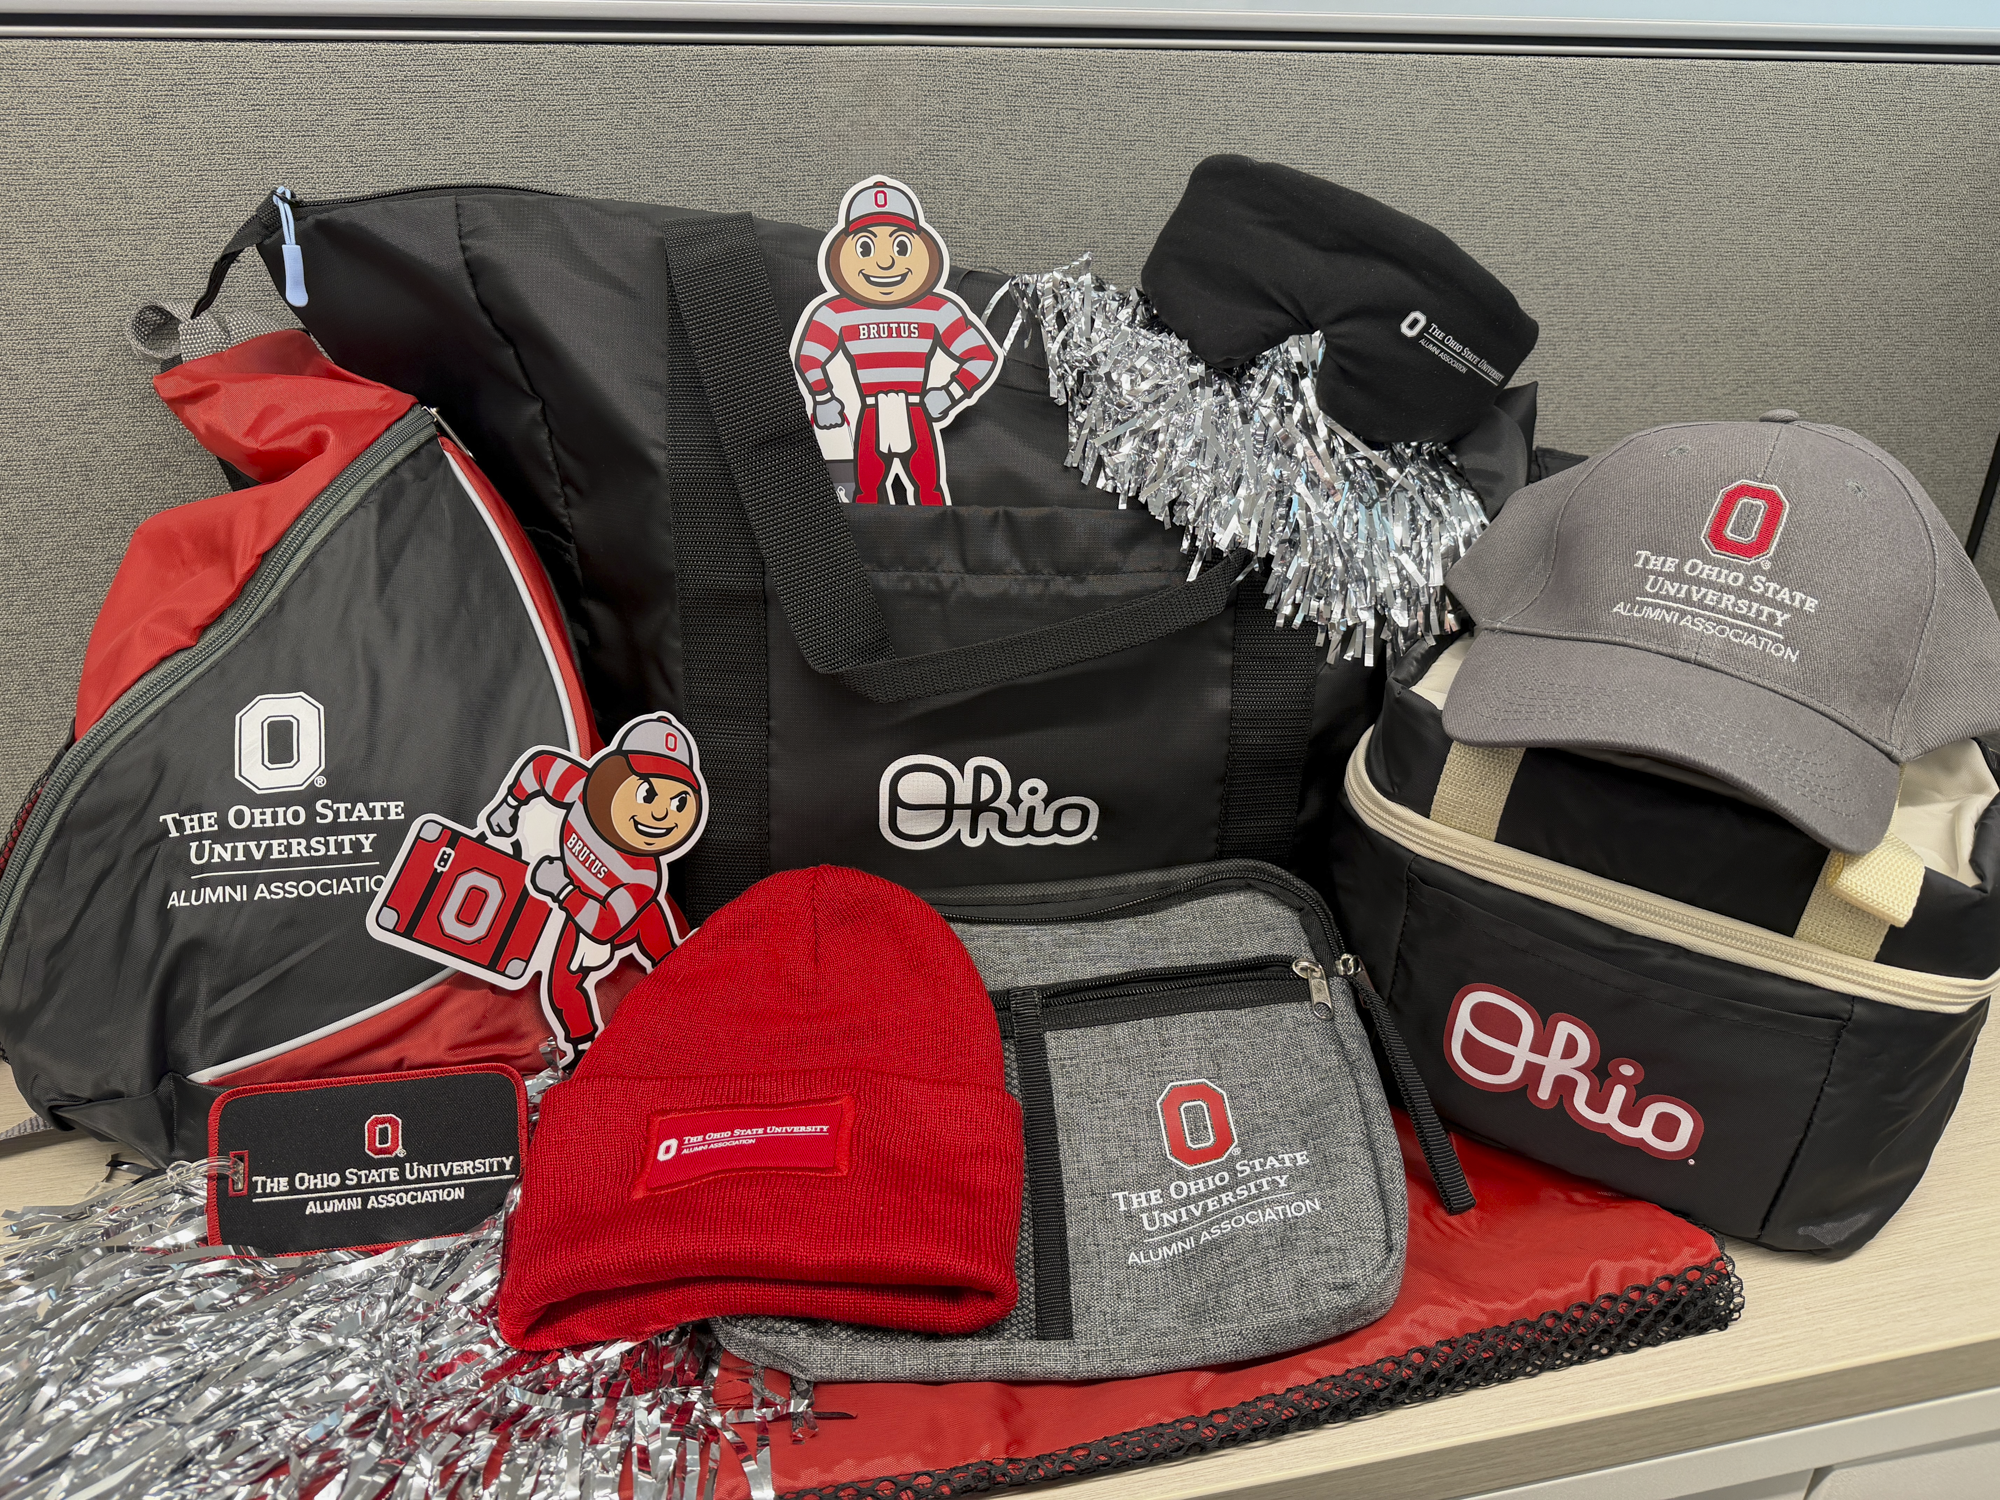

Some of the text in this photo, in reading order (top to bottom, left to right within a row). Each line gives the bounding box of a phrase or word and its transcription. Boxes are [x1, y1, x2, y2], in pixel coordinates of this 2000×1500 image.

[874, 189, 888, 209] O
[858, 322, 920, 340] BRUTUS
[1400, 310, 1427, 338] O
[1418, 338, 1468, 374] ALUMNI ASSOCIATION
[1428, 323, 1505, 382] THE OHIO STATE UNIVERSITY
[1701, 479, 1789, 565] O
[1633, 550, 1819, 613] THE OHIO STATE
[1645, 575, 1791, 627] UNIVERSITY
[1612, 601, 1800, 662] ALUMNI ASSOCIATION
[235, 691, 325, 794] O
[665, 732, 678, 752] O
[159, 799, 405, 838] THE OHIO STATE
[879, 754, 1099, 850] Ohio
[189, 833, 377, 865] UNIVERSITY
[567, 833, 608, 879] BRUTUS
[166, 874, 386, 909] ALUMNI ASSOCIATIO
[437, 867, 506, 945] O
[1444, 984, 1703, 1159] Ohio
[364, 1113, 402, 1158] O
[681, 1138, 756, 1155] ALUMNI ASSOCIATION
[683, 1125, 829, 1145] THE OHIO STATE UNIVERSITY
[1156, 1078, 1238, 1170] O
[656, 1137, 679, 1162] O
[252, 1156, 514, 1194] THE OHIO STATE UNIVERSITY
[1112, 1151, 1310, 1212] THE OHIO STATE
[305, 1187, 465, 1215] ALUMNI ASSOCIATION
[1140, 1174, 1290, 1232] UNIVERSITY
[1127, 1198, 1322, 1265] ALUMNI ASSOCIATION
